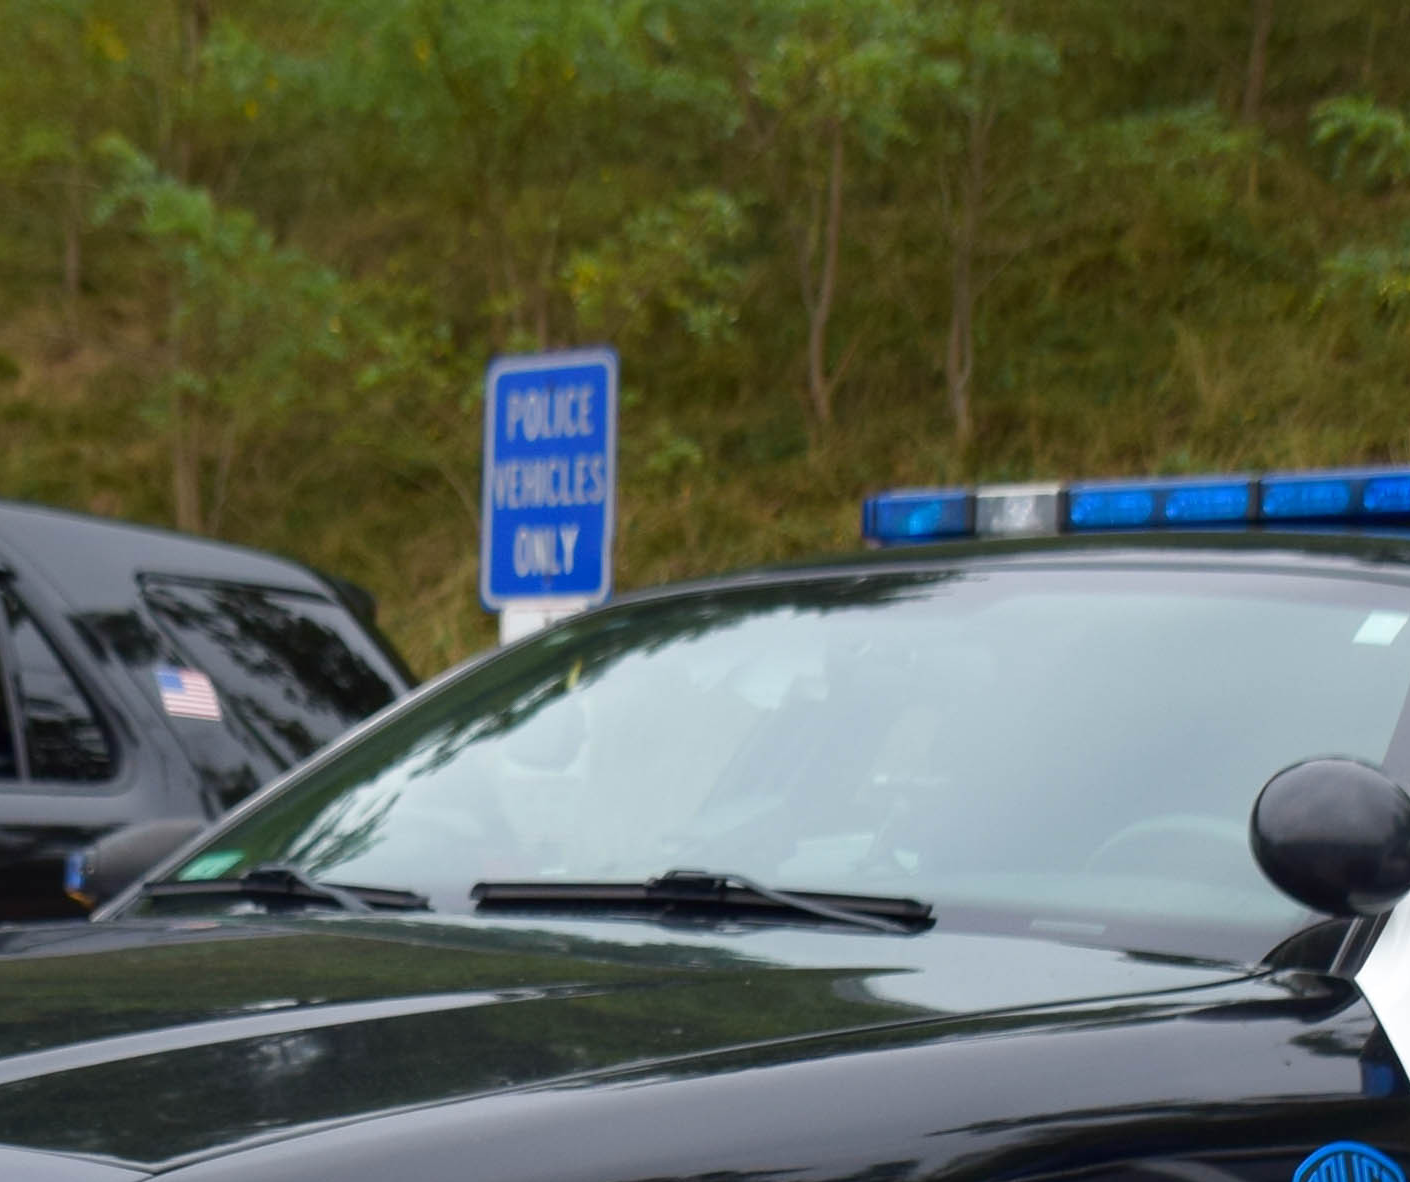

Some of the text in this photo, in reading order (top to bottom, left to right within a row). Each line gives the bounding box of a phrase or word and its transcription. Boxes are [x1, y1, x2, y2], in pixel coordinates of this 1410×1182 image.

[506, 386, 594, 442] POLICE
[494, 455, 606, 509] VEHICLES
[513, 523, 580, 578] ONLY
